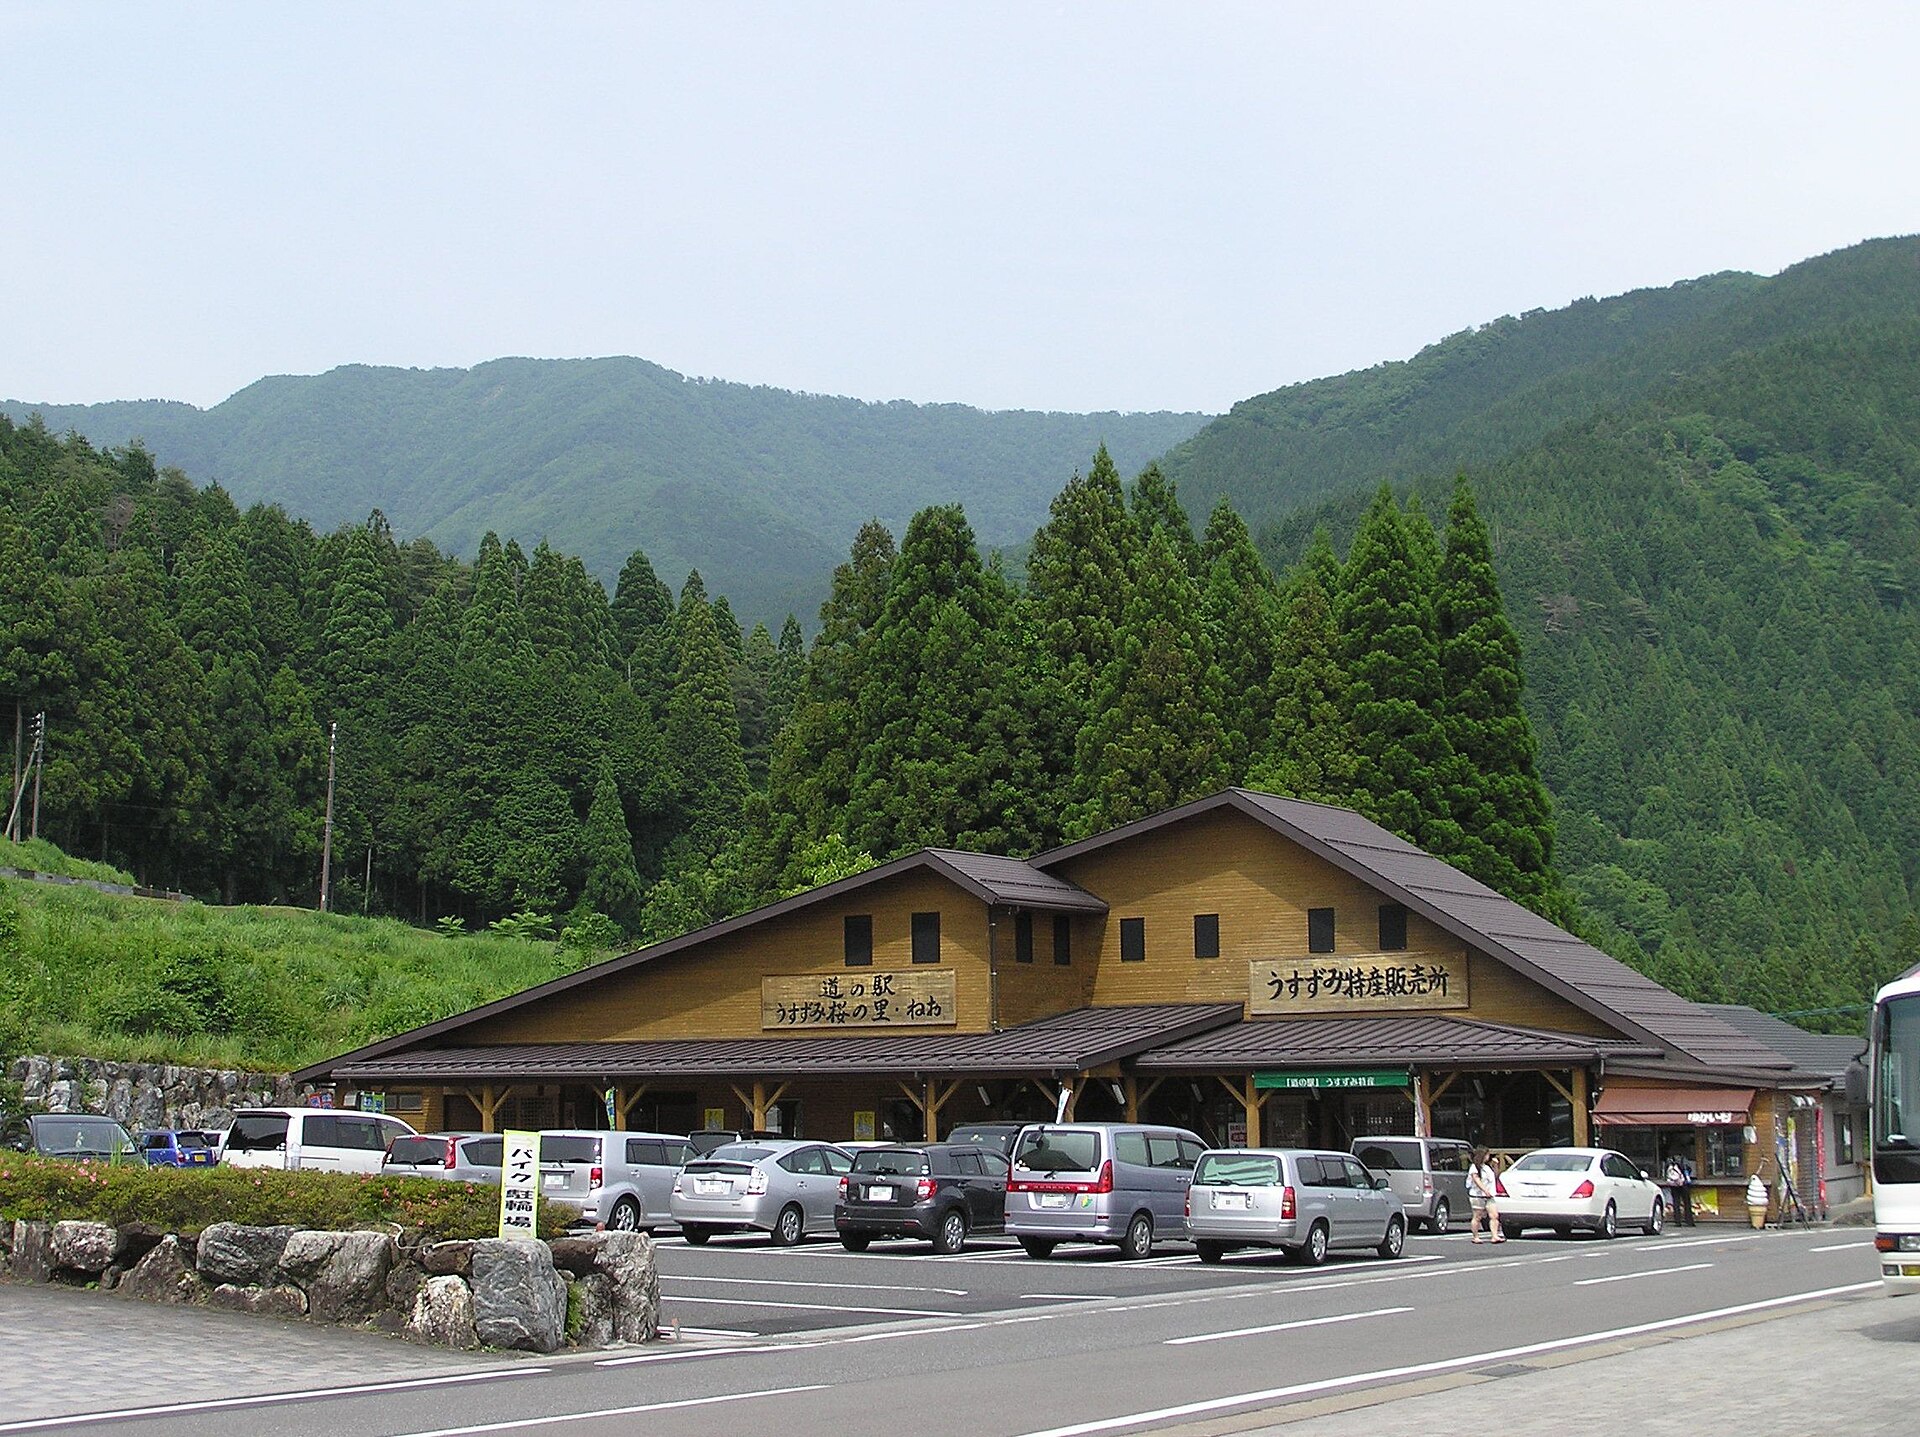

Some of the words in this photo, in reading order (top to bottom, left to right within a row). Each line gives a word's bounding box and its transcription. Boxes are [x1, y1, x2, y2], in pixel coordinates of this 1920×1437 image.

[818, 975, 896, 999] 道の駅
[1267, 965, 1449, 1000] うすずみ特産販売所
